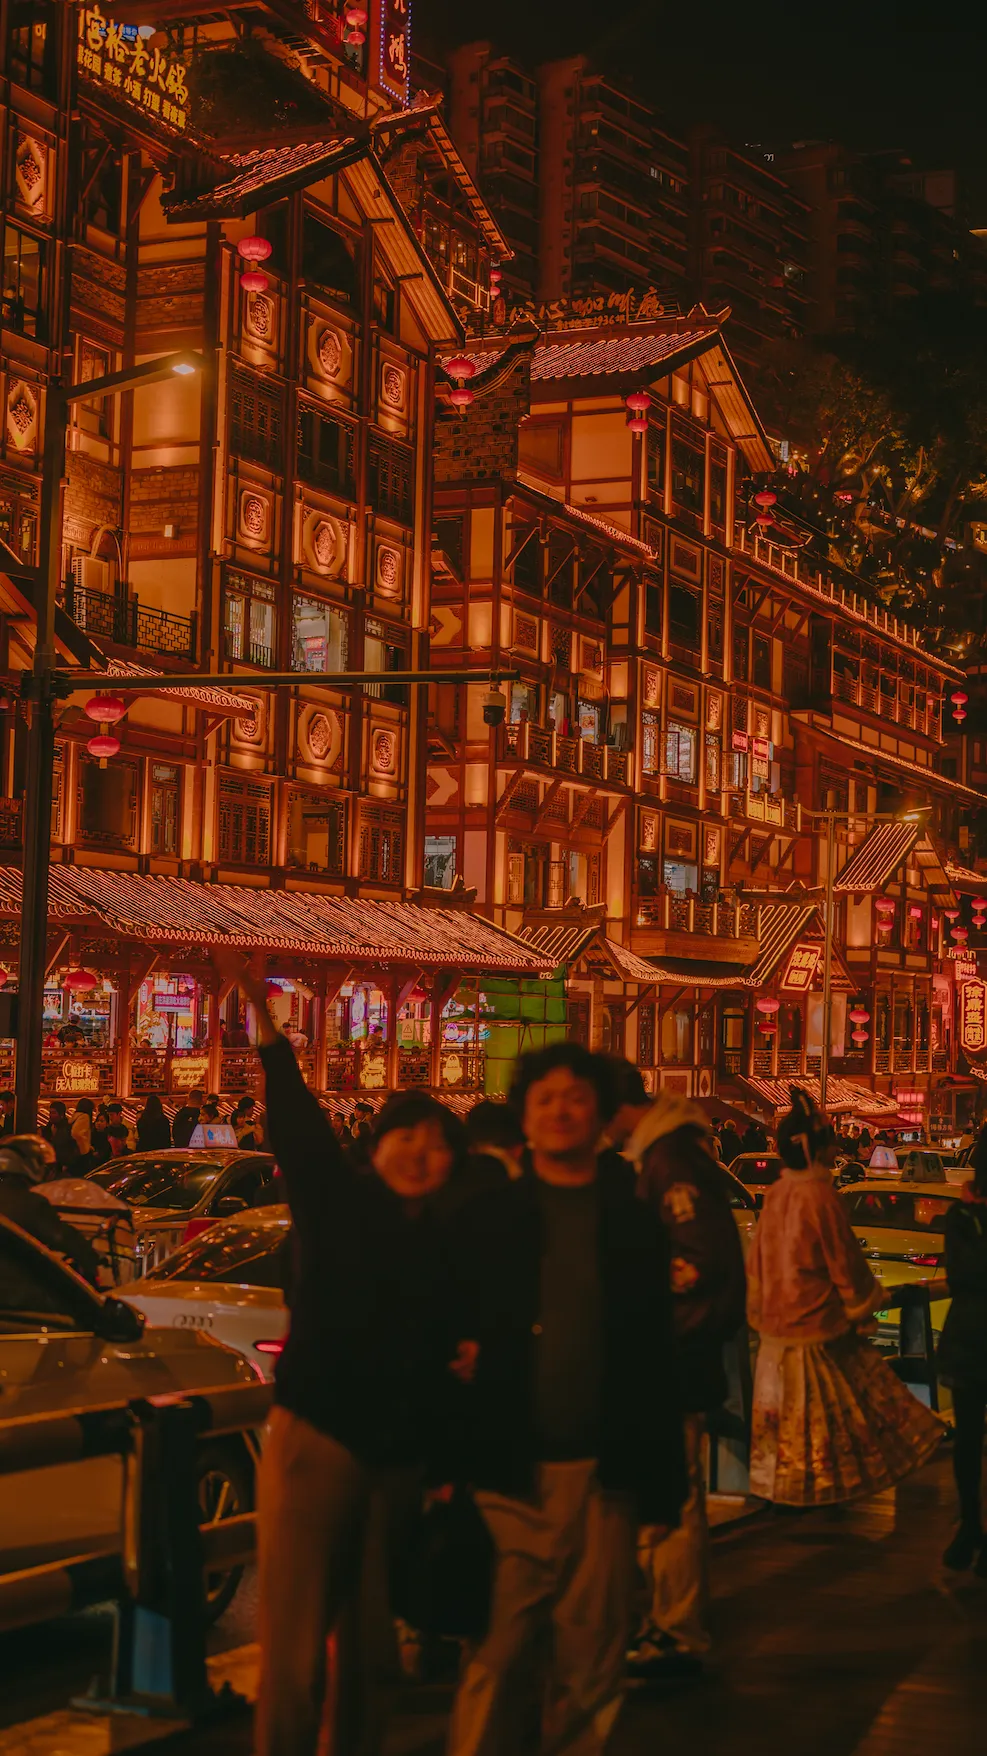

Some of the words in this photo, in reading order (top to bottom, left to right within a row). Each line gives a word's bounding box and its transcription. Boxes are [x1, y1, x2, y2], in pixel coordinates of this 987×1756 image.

[123, 76, 142, 101] 小酒
[964, 985, 984, 1024] 徐鼎盛
